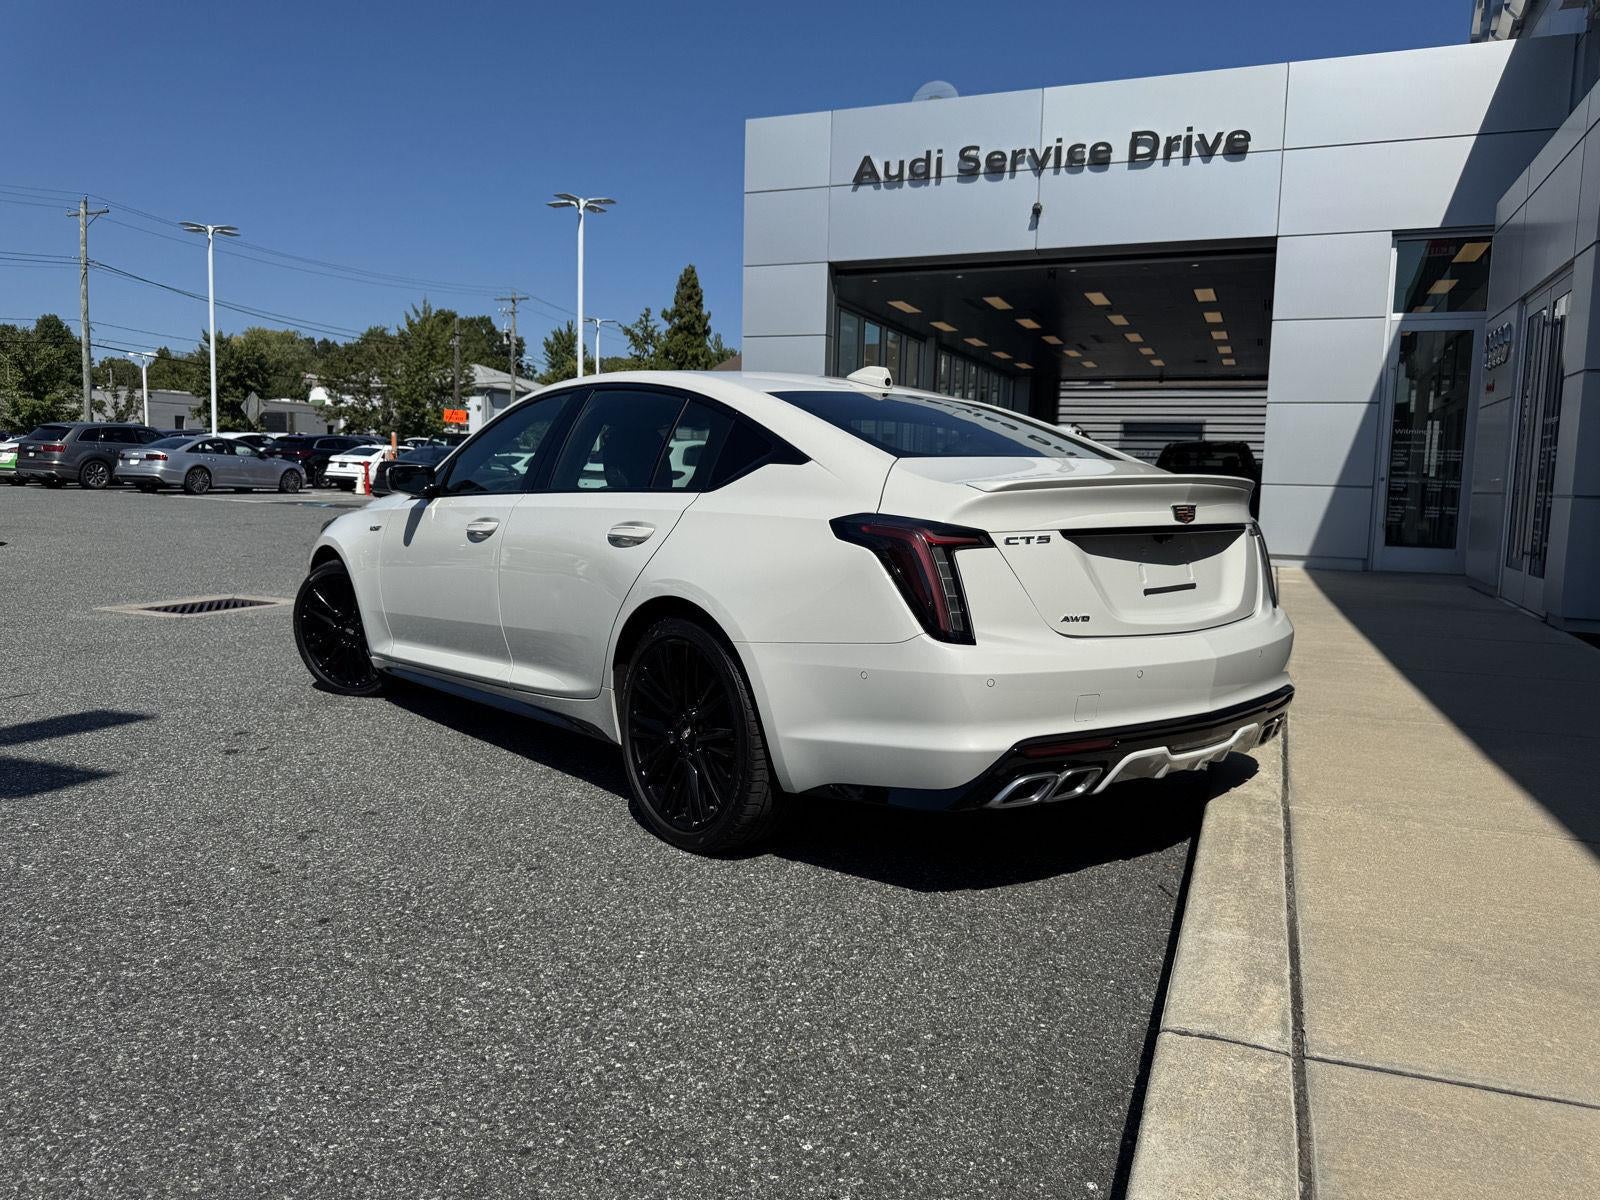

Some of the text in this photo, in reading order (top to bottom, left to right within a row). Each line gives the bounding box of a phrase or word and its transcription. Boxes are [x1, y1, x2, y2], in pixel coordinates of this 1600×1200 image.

[853, 126, 1252, 188] Audi Service Drive
[1060, 615, 1090, 623] AWD
